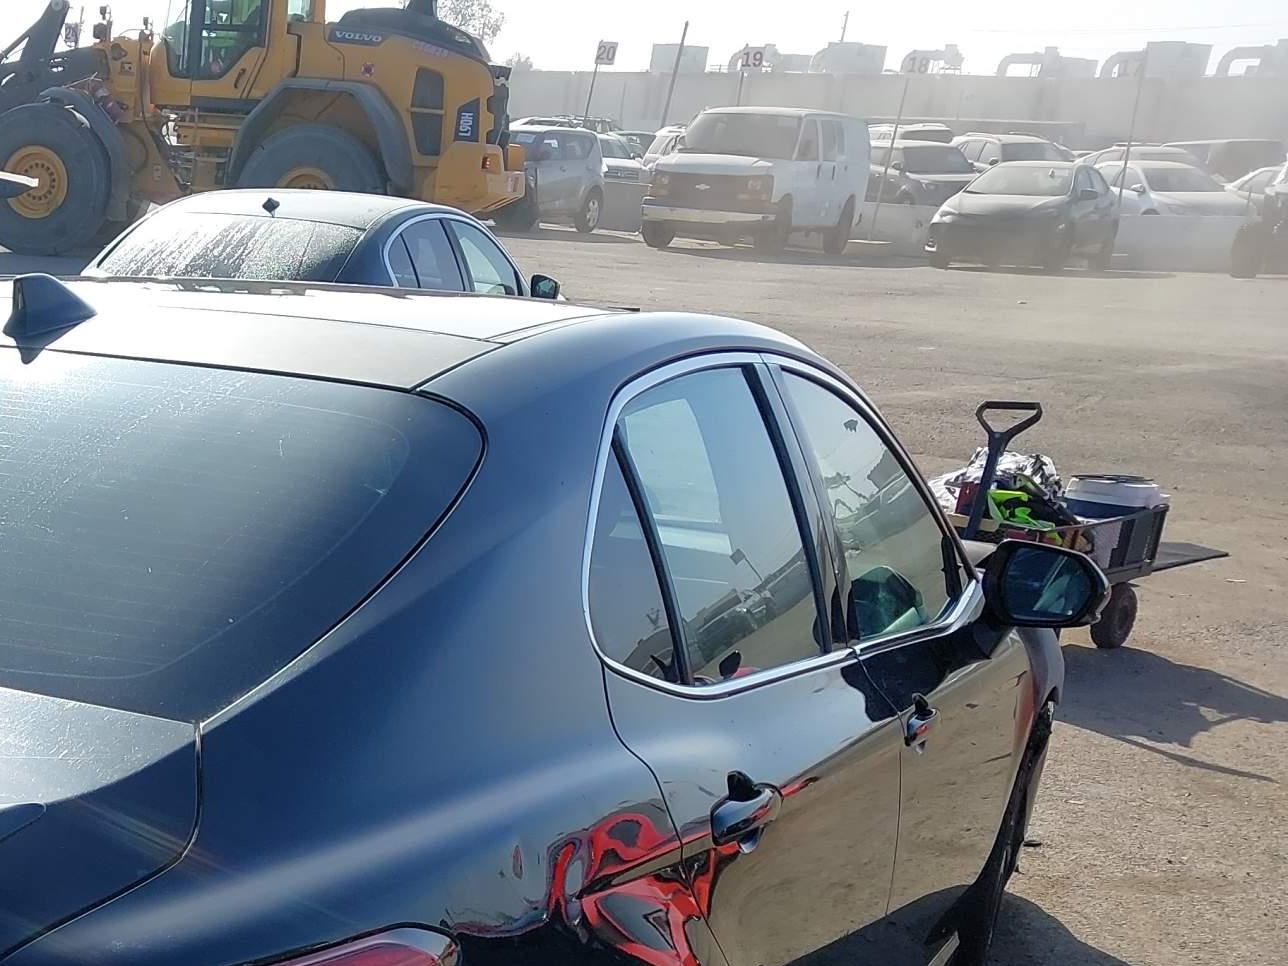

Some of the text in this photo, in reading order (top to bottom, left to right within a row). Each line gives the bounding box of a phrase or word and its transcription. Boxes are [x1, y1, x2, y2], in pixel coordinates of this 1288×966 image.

[335, 30, 382, 42] VOLVO
[598, 45, 616, 61] 20
[742, 51, 763, 67] 19
[458, 112, 474, 137] L90H
